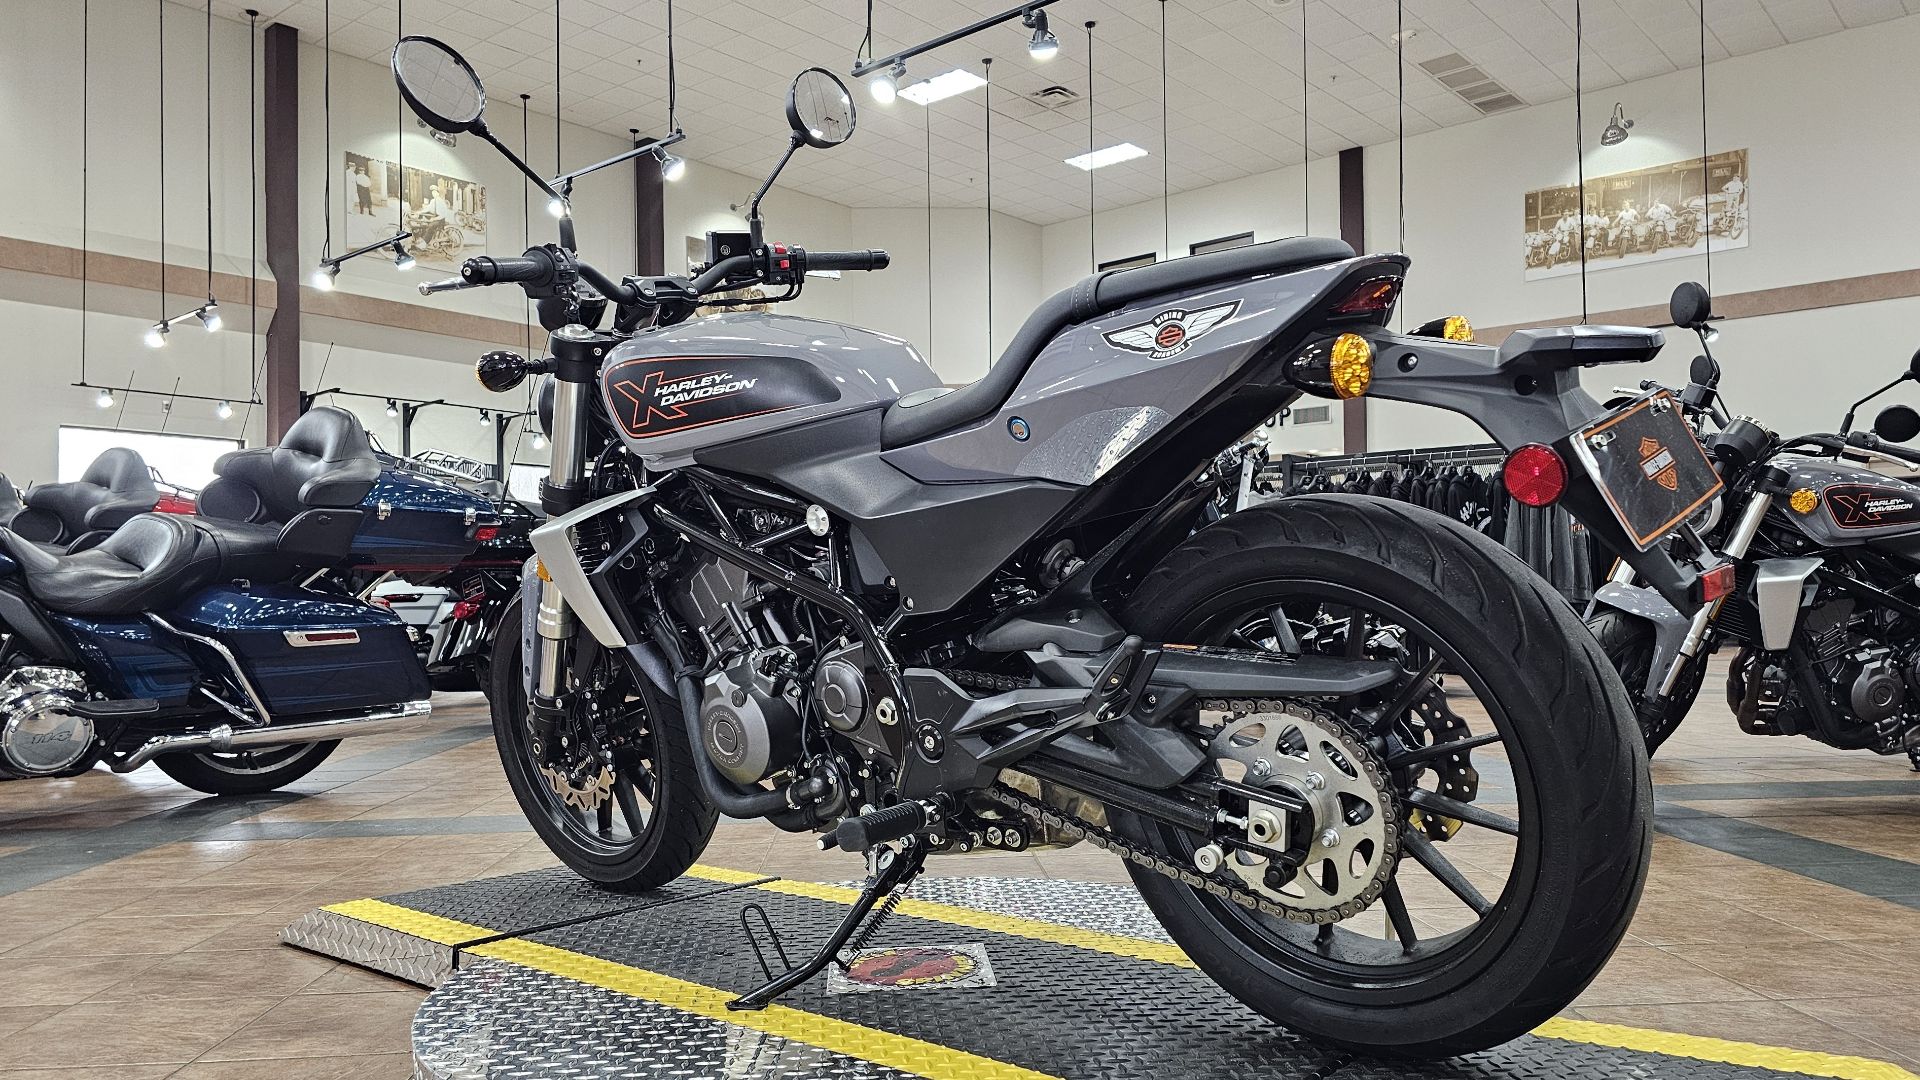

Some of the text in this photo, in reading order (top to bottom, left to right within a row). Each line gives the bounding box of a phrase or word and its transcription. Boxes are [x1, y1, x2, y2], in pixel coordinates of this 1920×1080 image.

[653, 372, 733, 398] HARLEY-
[659, 378, 758, 407] DAVIDSON
[1864, 498, 1904, 508] HARLEY-
[1867, 503, 1913, 513] DAVIDSON
